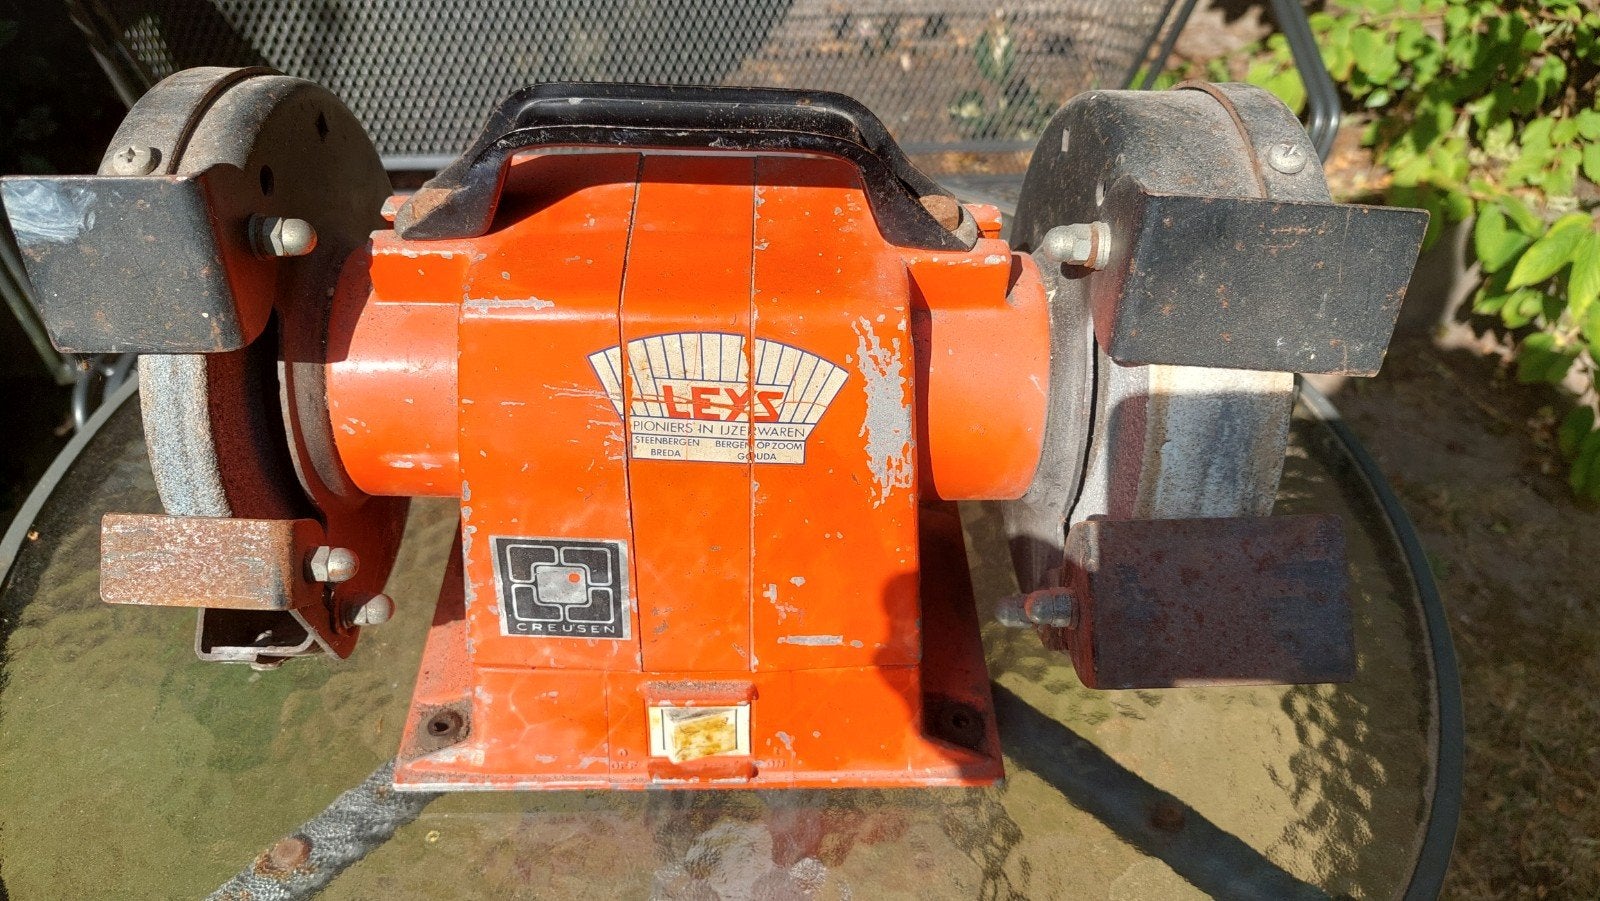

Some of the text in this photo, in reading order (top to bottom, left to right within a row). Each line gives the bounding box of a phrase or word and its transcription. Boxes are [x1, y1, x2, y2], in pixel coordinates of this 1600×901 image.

[633, 420, 694, 434] PIONIERS
[698, 423, 714, 435] IN
[635, 435, 700, 446] STEENBERGEN
[756, 441, 771, 450] OP
[772, 442, 803, 451] ZOOM
[650, 448, 682, 458] BREDA
[516, 622, 615, 634] CREUSEN
